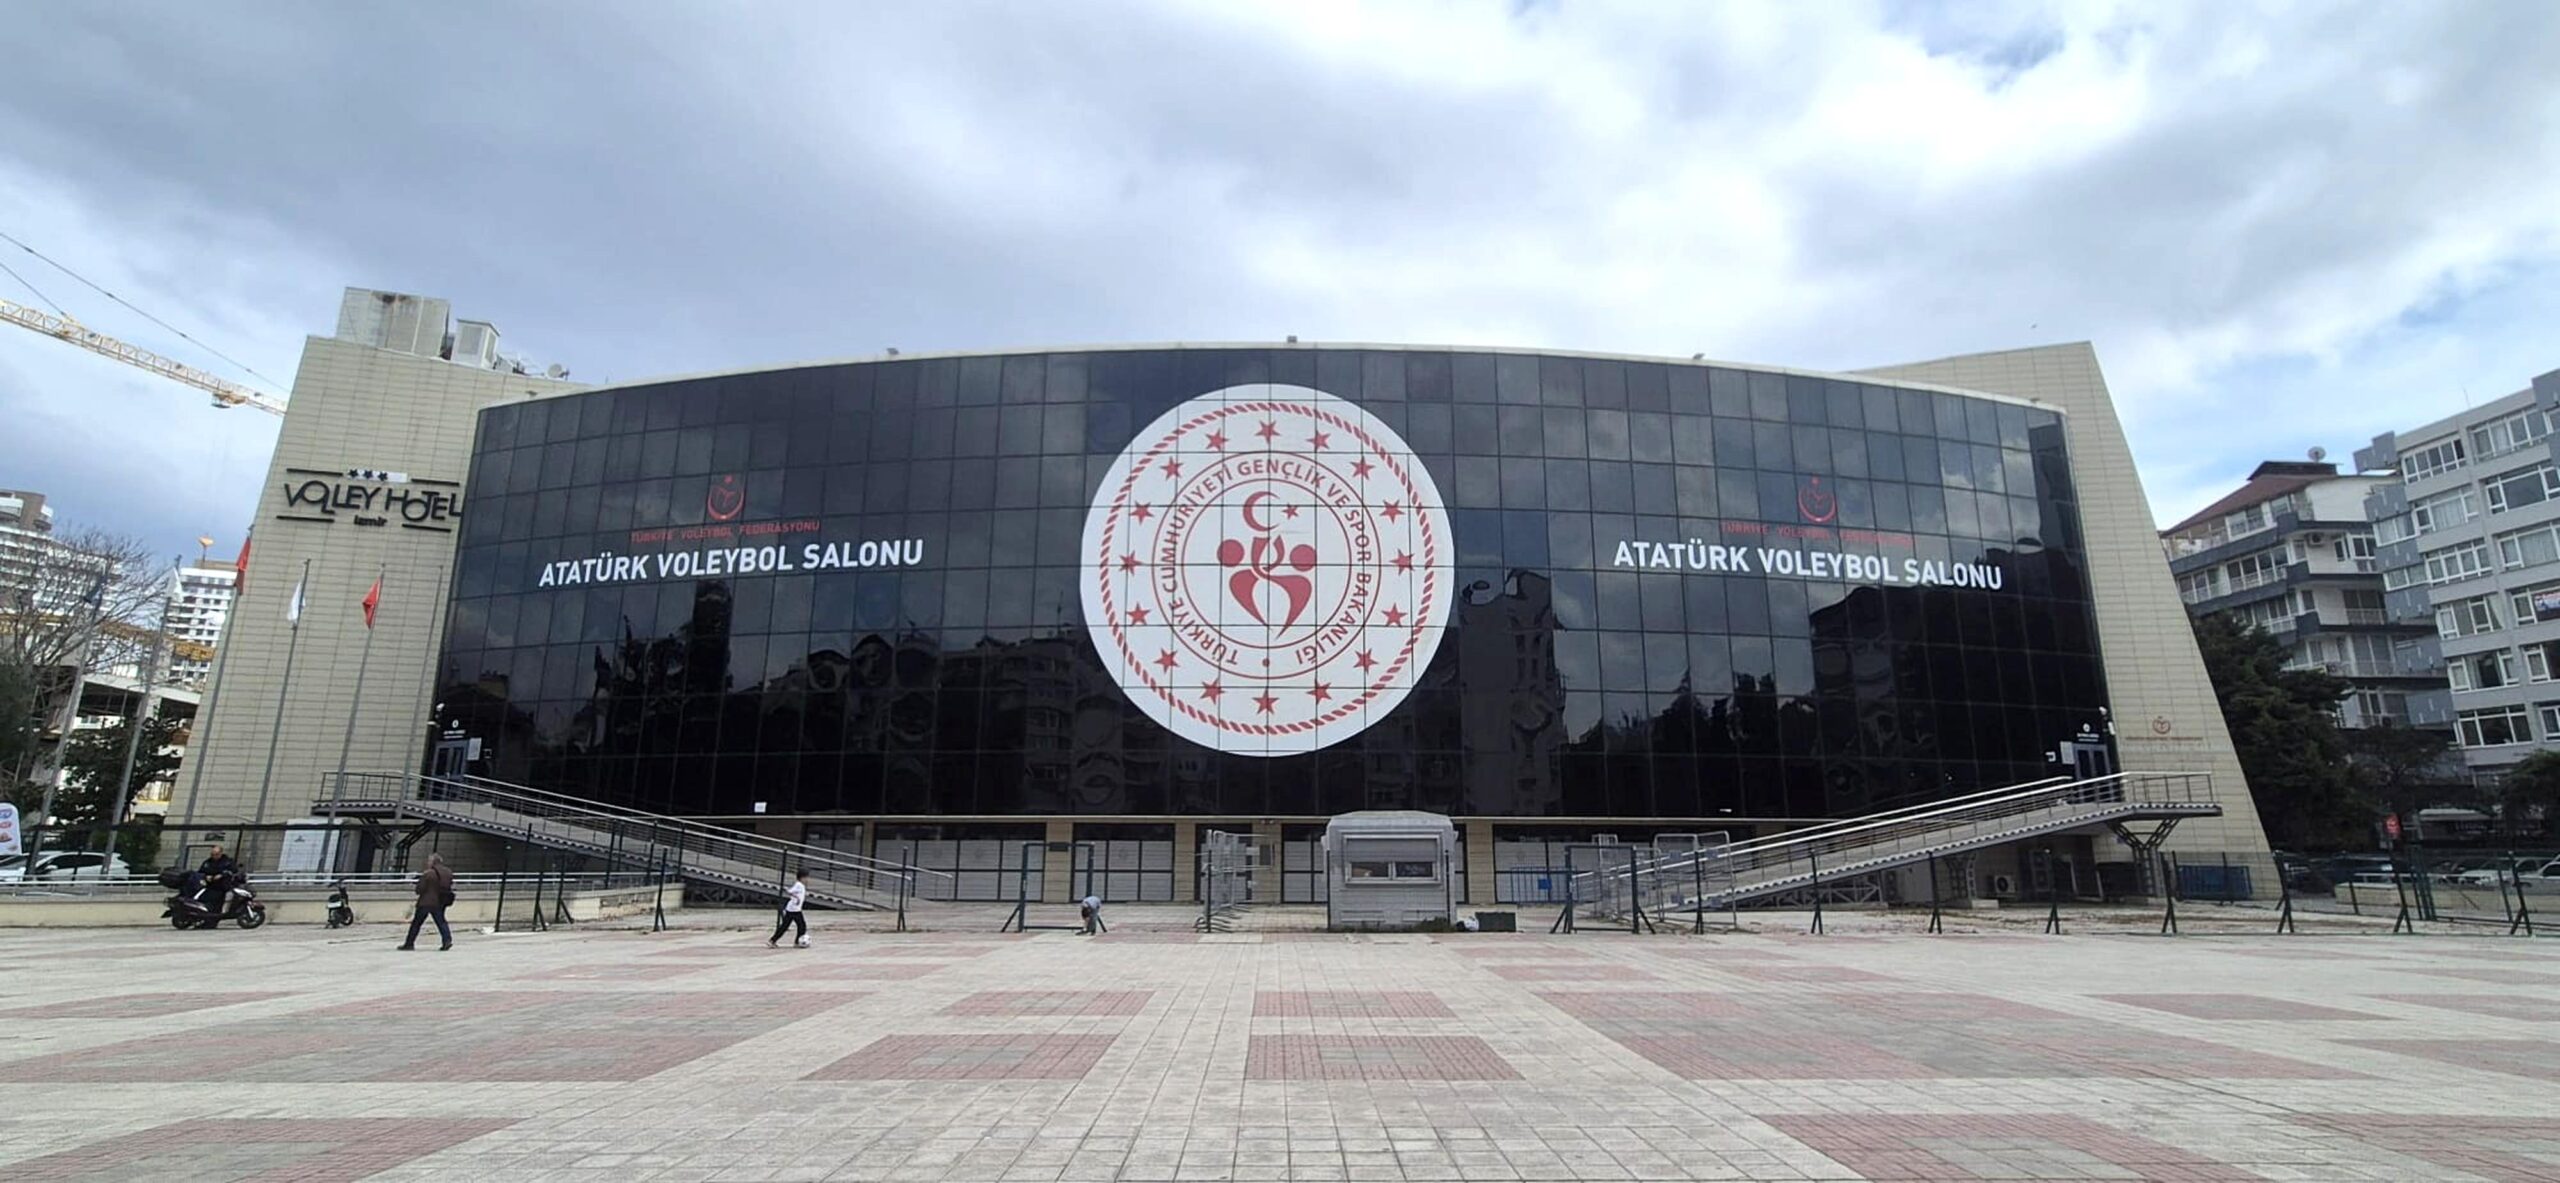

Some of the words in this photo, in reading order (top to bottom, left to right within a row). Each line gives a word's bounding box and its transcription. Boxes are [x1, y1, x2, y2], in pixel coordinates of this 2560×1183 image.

[1237, 459, 1326, 488] GENÇLİK
[1327, 483, 1350, 508] VE
[385, 487, 463, 522] HOTEL
[1161, 463, 1233, 593] CUMHURİYETİ
[1344, 509, 1372, 562] SPOR
[538, 551, 648, 587] ATATÜRK
[657, 545, 793, 578] VOLEYBOL
[803, 538, 923, 569] SALONU
[1613, 538, 1750, 572] ATATÜRK
[1757, 547, 1899, 582] VOLEYBOL
[1904, 559, 2002, 590] SALONU
[1168, 597, 1238, 665] TÜRKİYE
[1296, 573, 1372, 665] BAKANLIĞI
